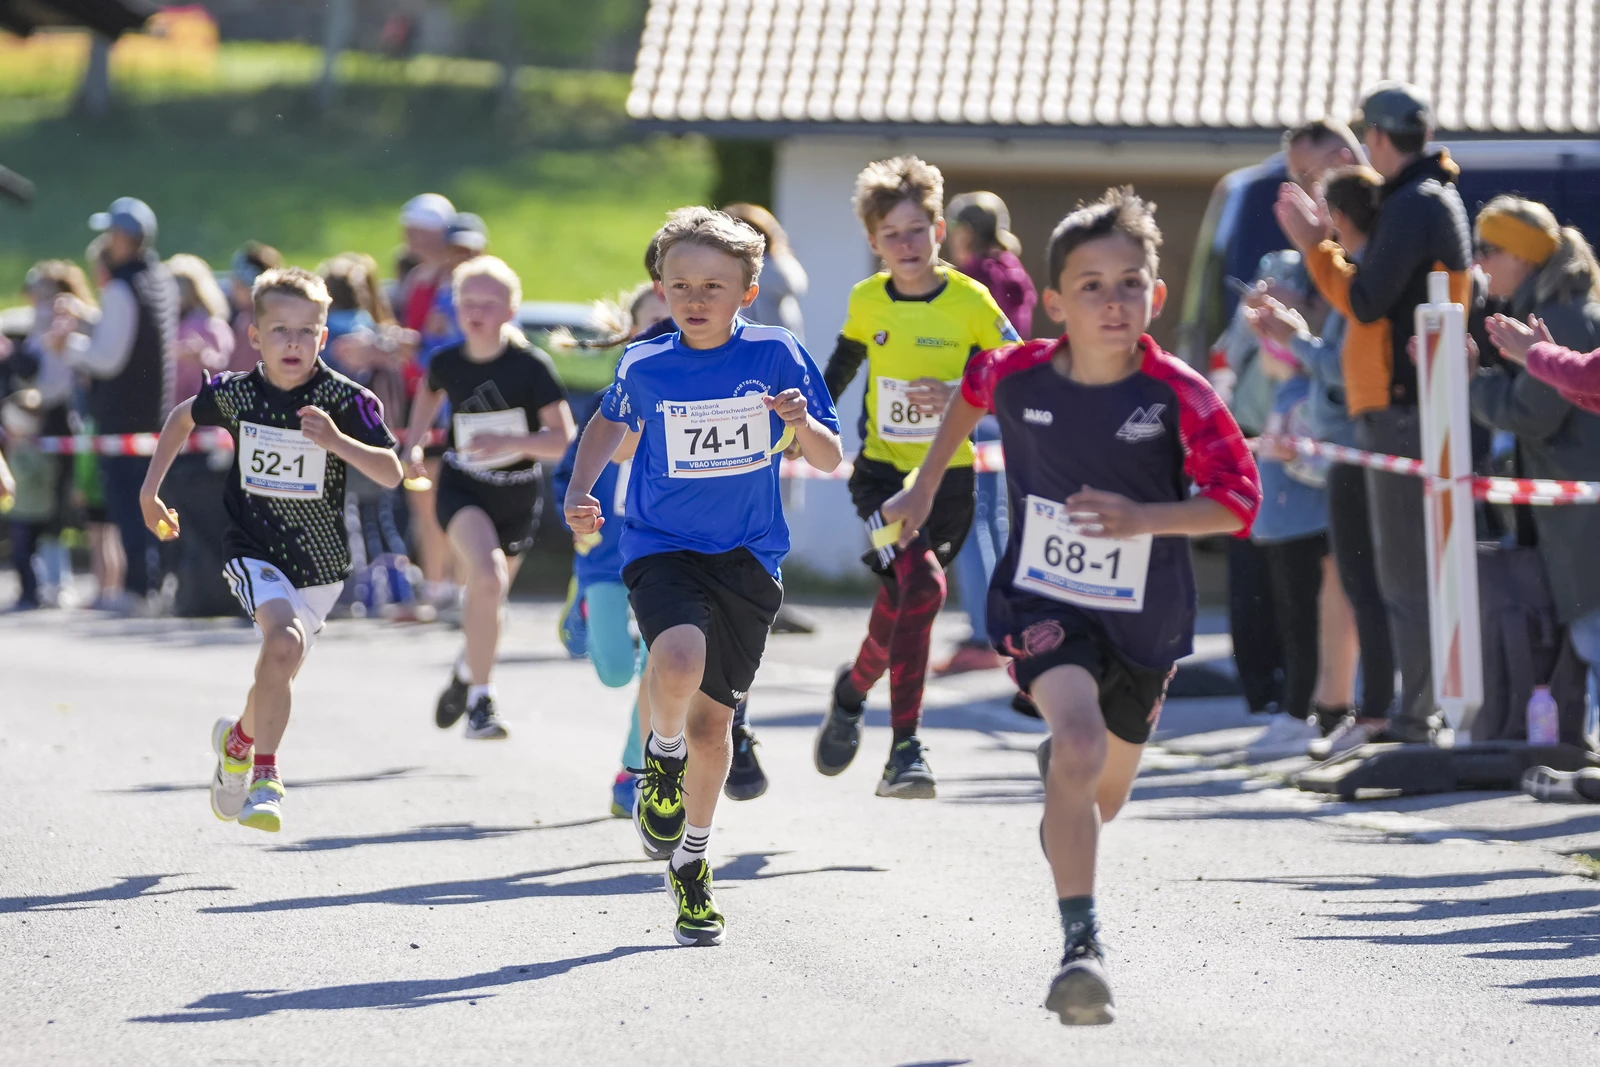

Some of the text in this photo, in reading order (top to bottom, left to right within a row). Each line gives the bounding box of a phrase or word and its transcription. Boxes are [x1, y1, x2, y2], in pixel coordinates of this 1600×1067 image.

[690, 403, 719, 411] Volksbank
[690, 406, 755, 417] Allgäu-Oberschwaben
[891, 401, 942, 424] 86-
[1023, 408, 1053, 425] JAKO
[684, 423, 749, 455] 74-1
[251, 449, 304, 478] 52-1
[689, 457, 753, 469] VBAO Voralpencup
[1044, 534, 1121, 579] 68-1
[1043, 572, 1117, 596] VBAO Voralpencup
